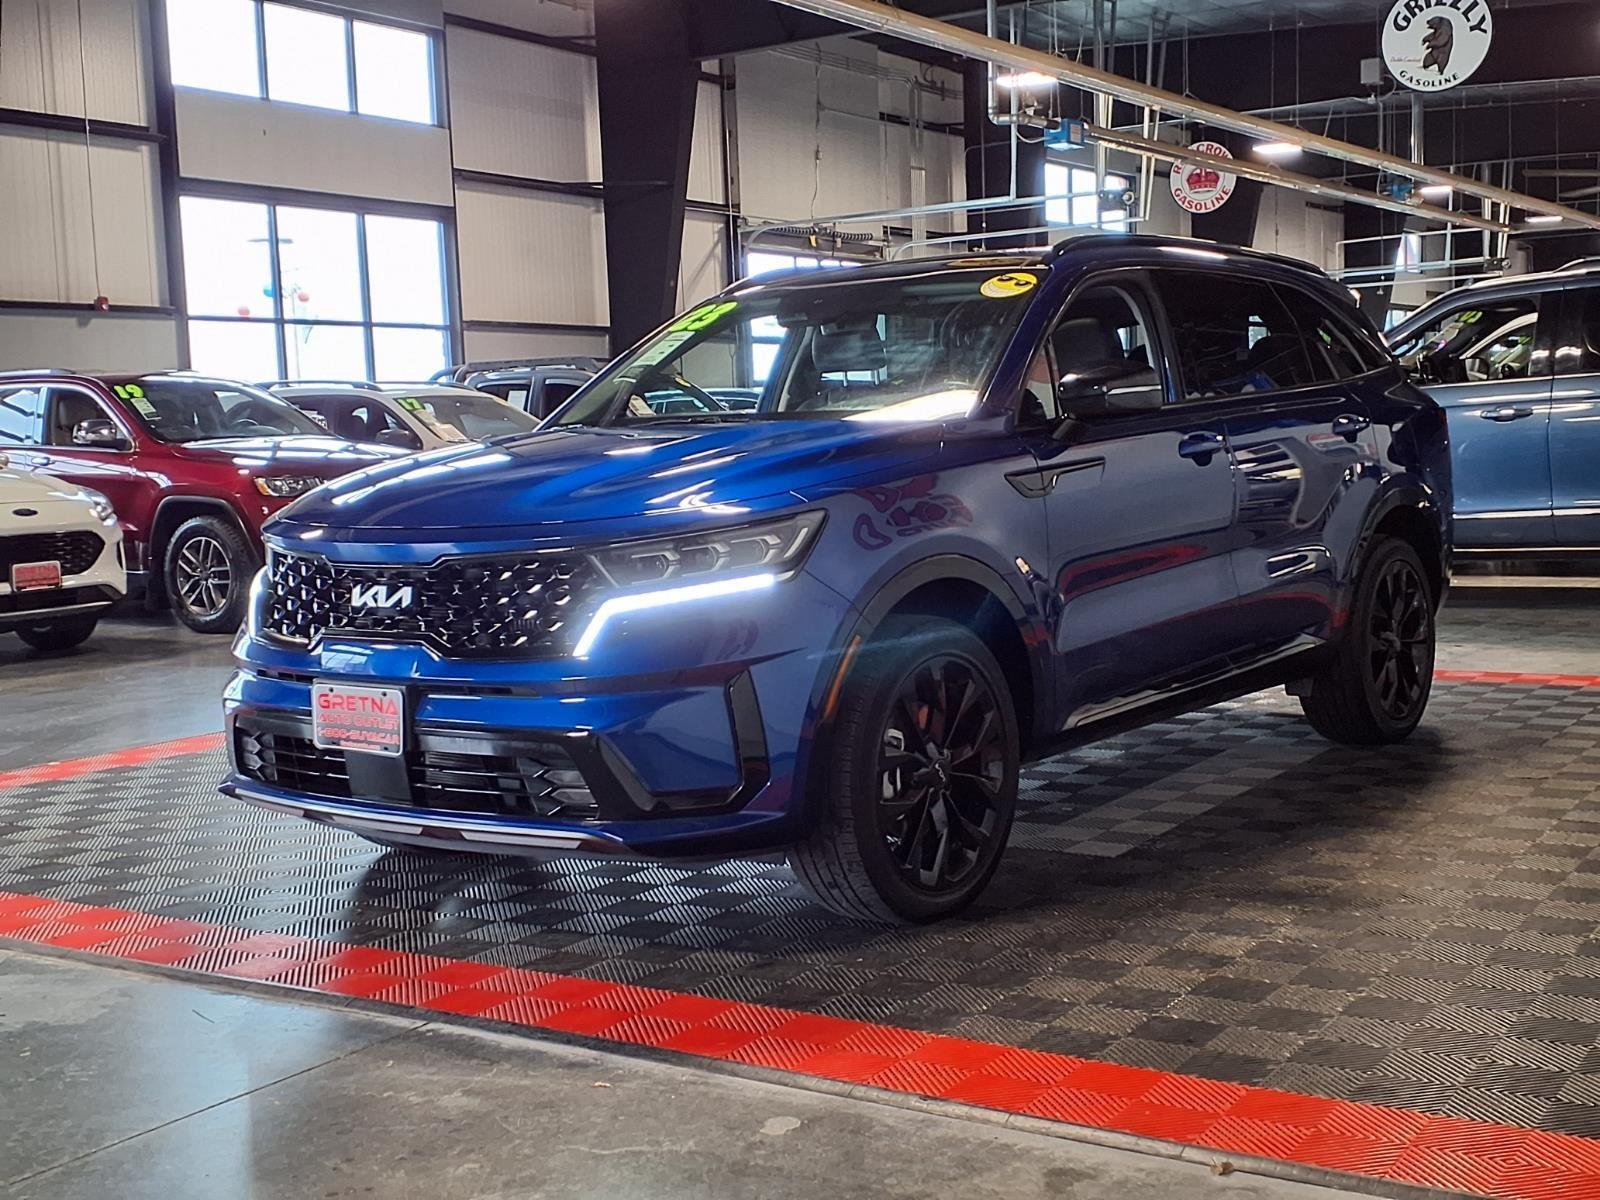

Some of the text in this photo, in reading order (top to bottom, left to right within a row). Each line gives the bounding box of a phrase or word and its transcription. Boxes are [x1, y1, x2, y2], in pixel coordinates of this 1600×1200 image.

[1399, 70, 1460, 88] GASOLINE
[1196, 143, 1230, 158] CRO
[1174, 186, 1232, 211] GASOLINE
[113, 383, 145, 399] 19
[396, 397, 422, 411] 17
[351, 583, 413, 609] KIA
[318, 693, 399, 716] GRETNA
[319, 713, 399, 731] AUTO OUTLET
